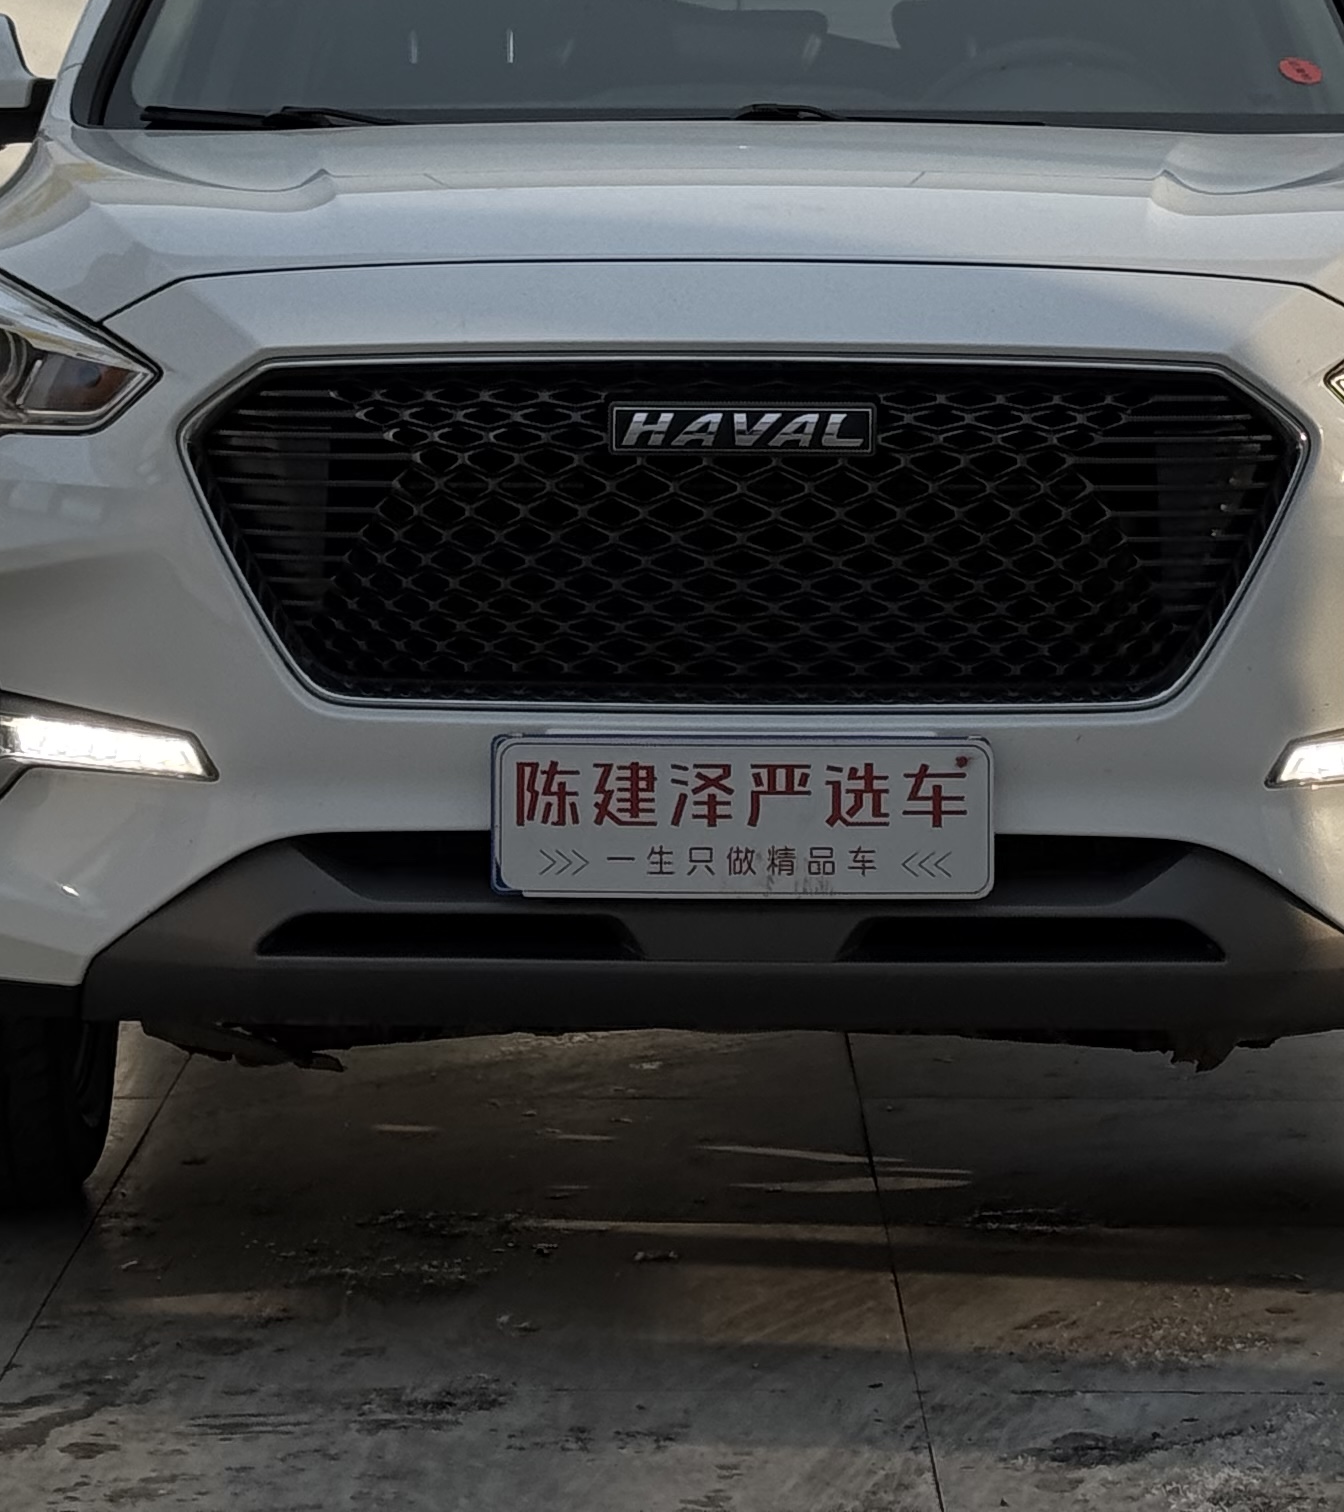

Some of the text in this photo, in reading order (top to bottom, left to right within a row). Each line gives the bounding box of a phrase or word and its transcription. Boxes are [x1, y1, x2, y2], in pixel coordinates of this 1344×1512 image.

[621, 413, 864, 447] HAVAL
[516, 760, 968, 828] 陈建泽严选车
[606, 845, 878, 877] 一生只做精品车
